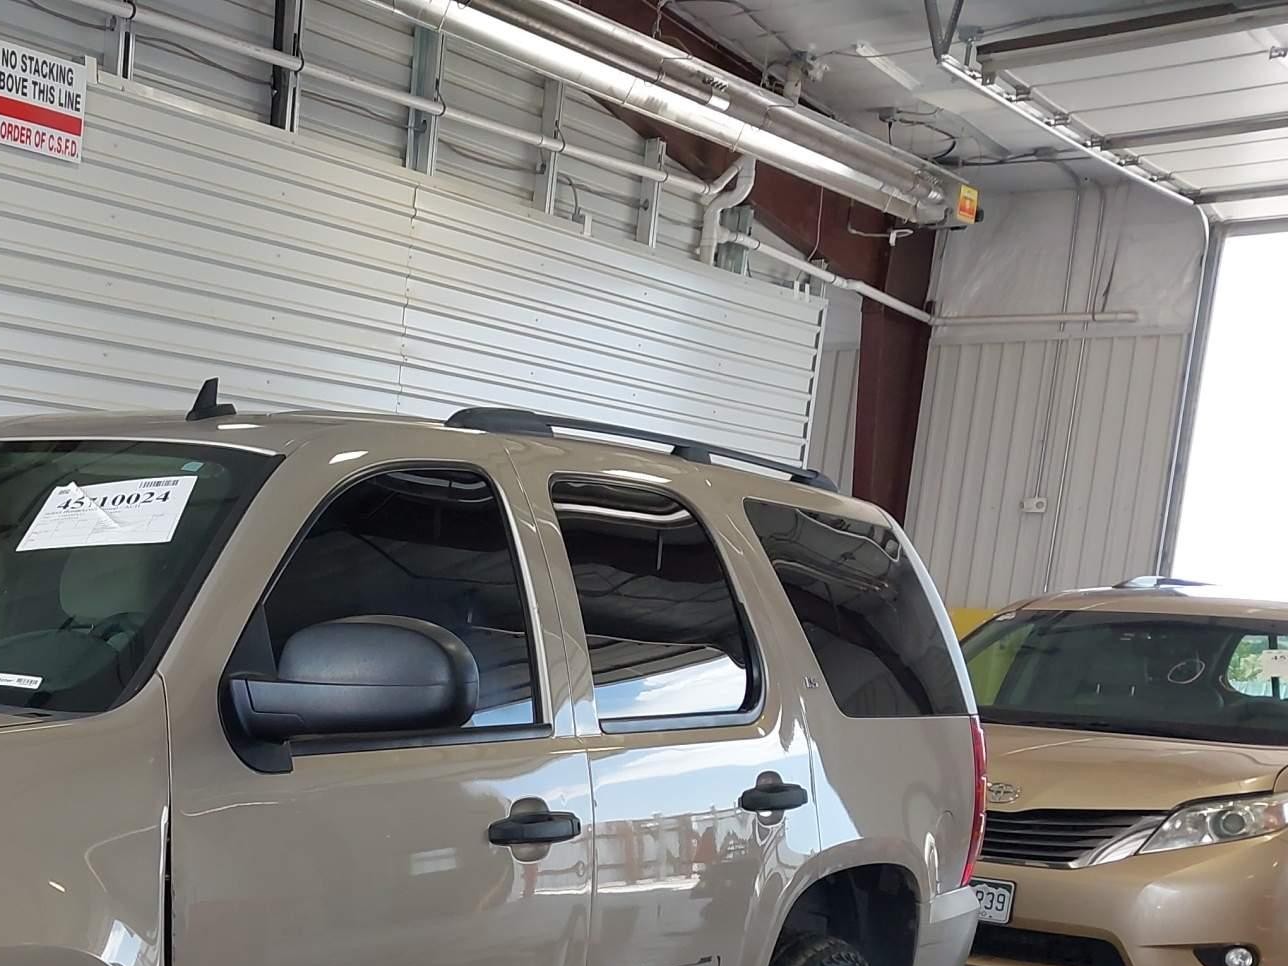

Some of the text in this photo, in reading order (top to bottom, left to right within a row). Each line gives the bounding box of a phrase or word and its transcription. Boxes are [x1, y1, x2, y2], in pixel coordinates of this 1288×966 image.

[2, 48, 74, 86] NO STACKING
[32, 80, 55, 104] THIS
[58, 89, 81, 112] LINE
[0, 121, 32, 146] ORDER
[34, 130, 46, 152] OF
[48, 134, 79, 158] C.S.F.D.
